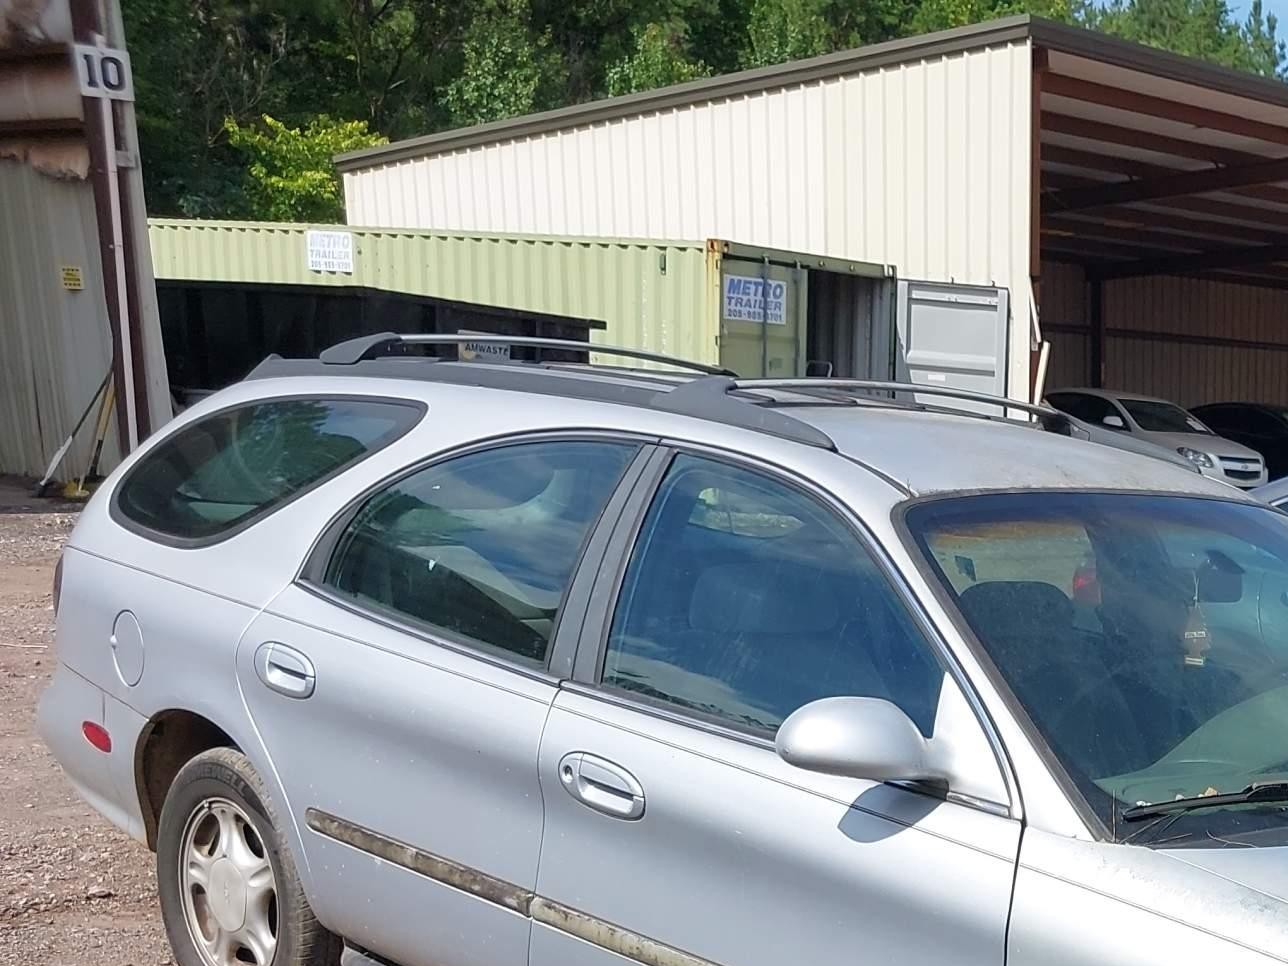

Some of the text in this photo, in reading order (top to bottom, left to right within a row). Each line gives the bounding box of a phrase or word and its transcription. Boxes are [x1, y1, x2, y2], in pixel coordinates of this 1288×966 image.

[82, 54, 126, 91] 10
[310, 249, 350, 260] TRAILER
[727, 278, 784, 300] METRO
[727, 296, 782, 311] TRAILER
